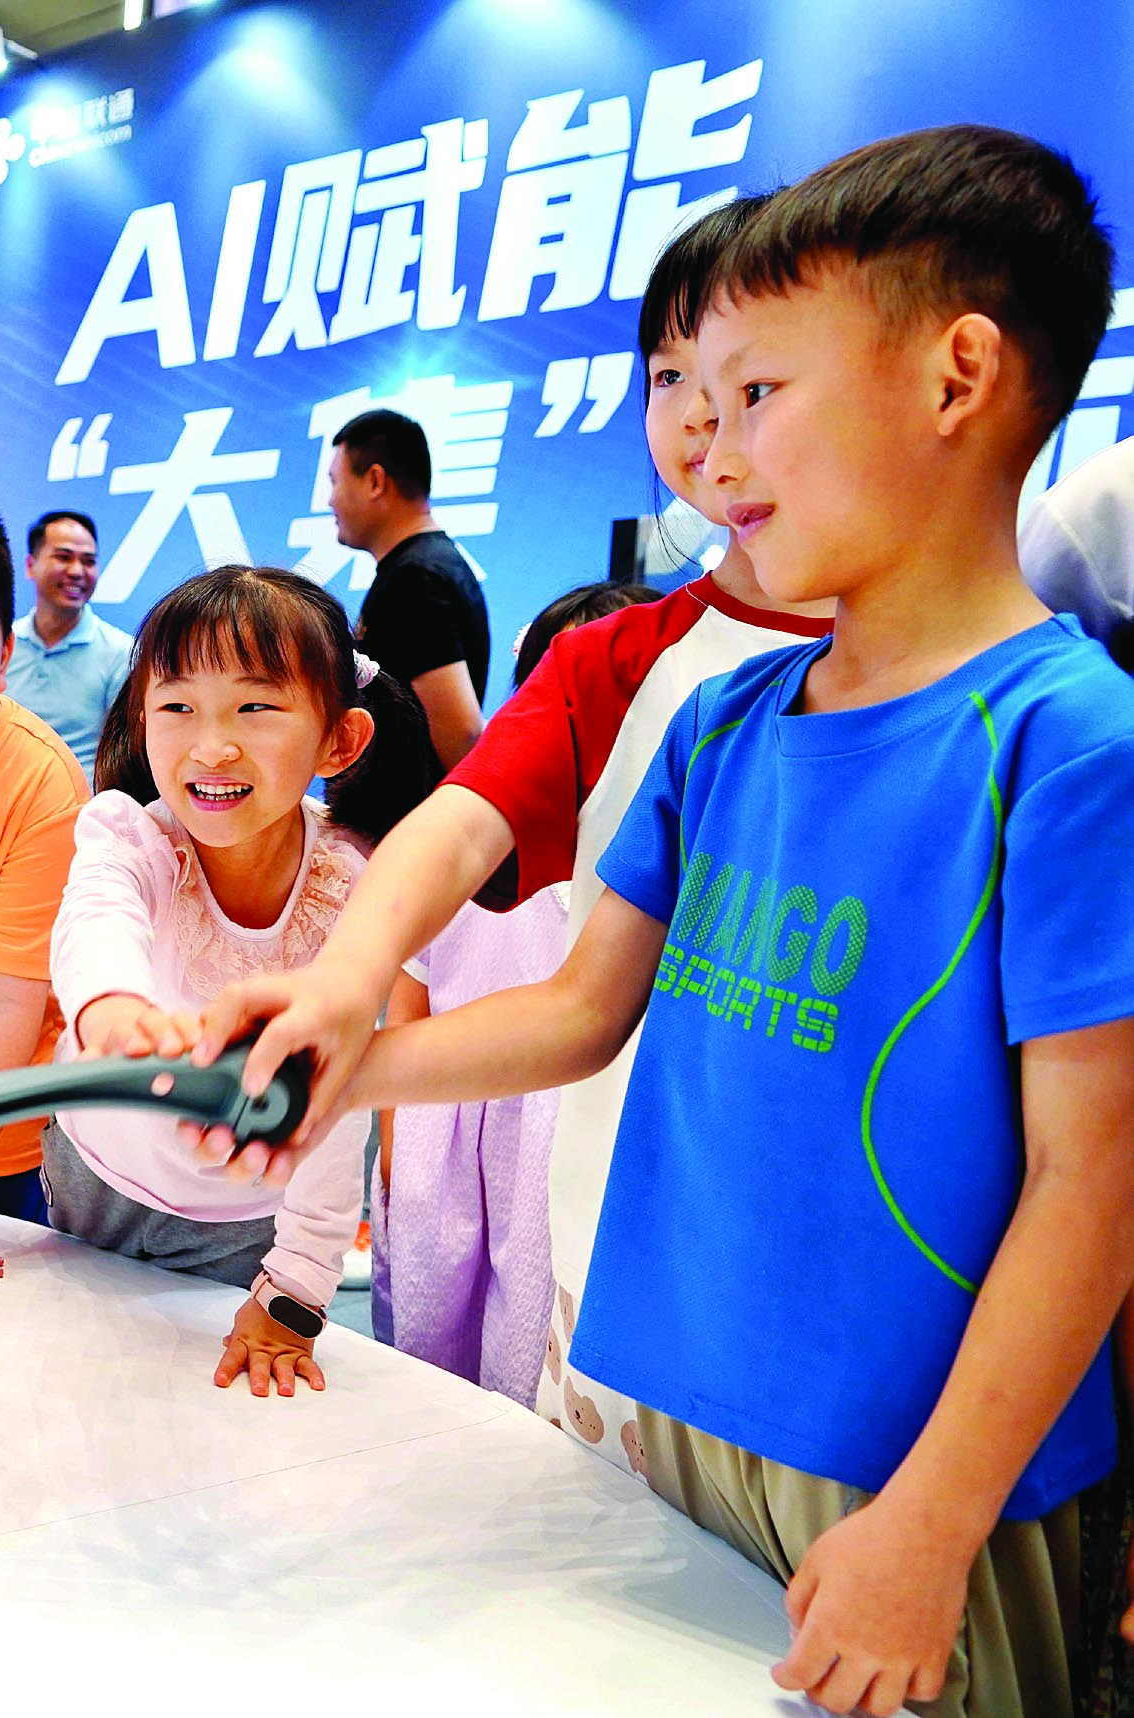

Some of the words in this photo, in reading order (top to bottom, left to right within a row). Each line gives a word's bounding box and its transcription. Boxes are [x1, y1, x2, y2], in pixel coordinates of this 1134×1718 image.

[54, 57, 764, 387] AI赋能
[667, 851, 869, 996] MANGO
[654, 943, 839, 1053] SPORTS
